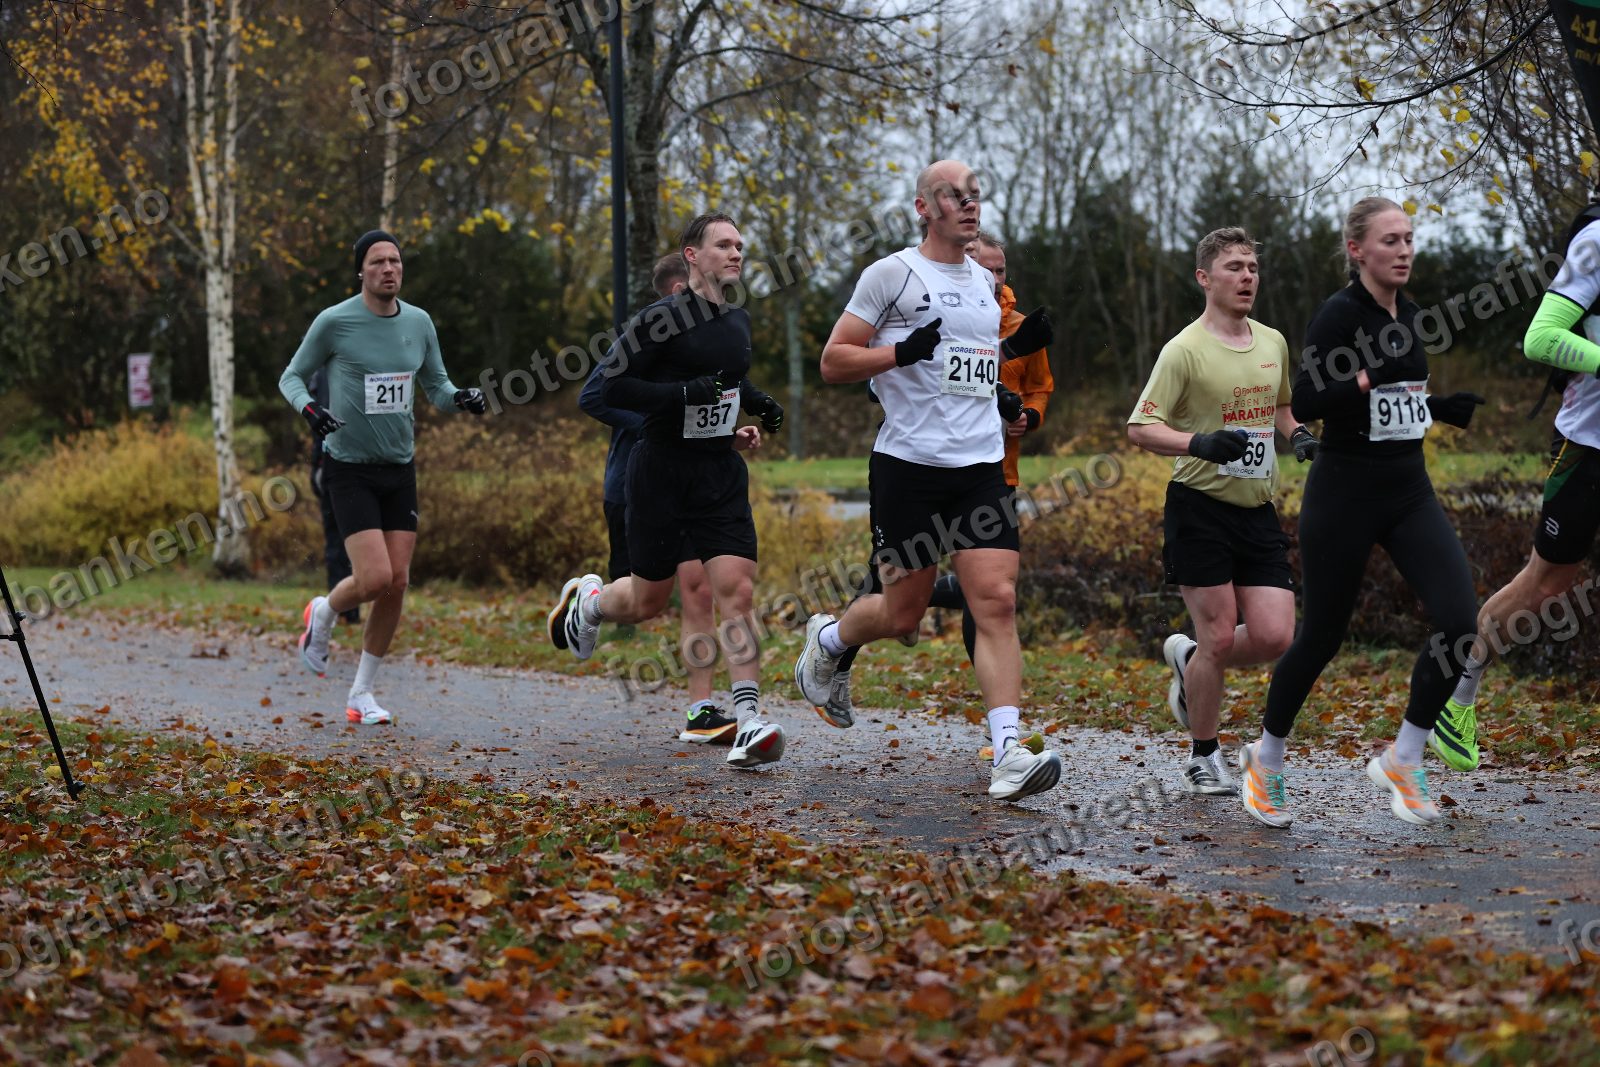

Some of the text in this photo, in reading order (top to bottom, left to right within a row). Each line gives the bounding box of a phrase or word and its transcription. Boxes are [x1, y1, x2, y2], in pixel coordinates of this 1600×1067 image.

[948, 355, 995, 386] 2140
[376, 383, 404, 404] 211
[1221, 395, 1277, 412] BERGEN CIT
[696, 402, 732, 428] 357
[1378, 395, 1426, 427] 9118
